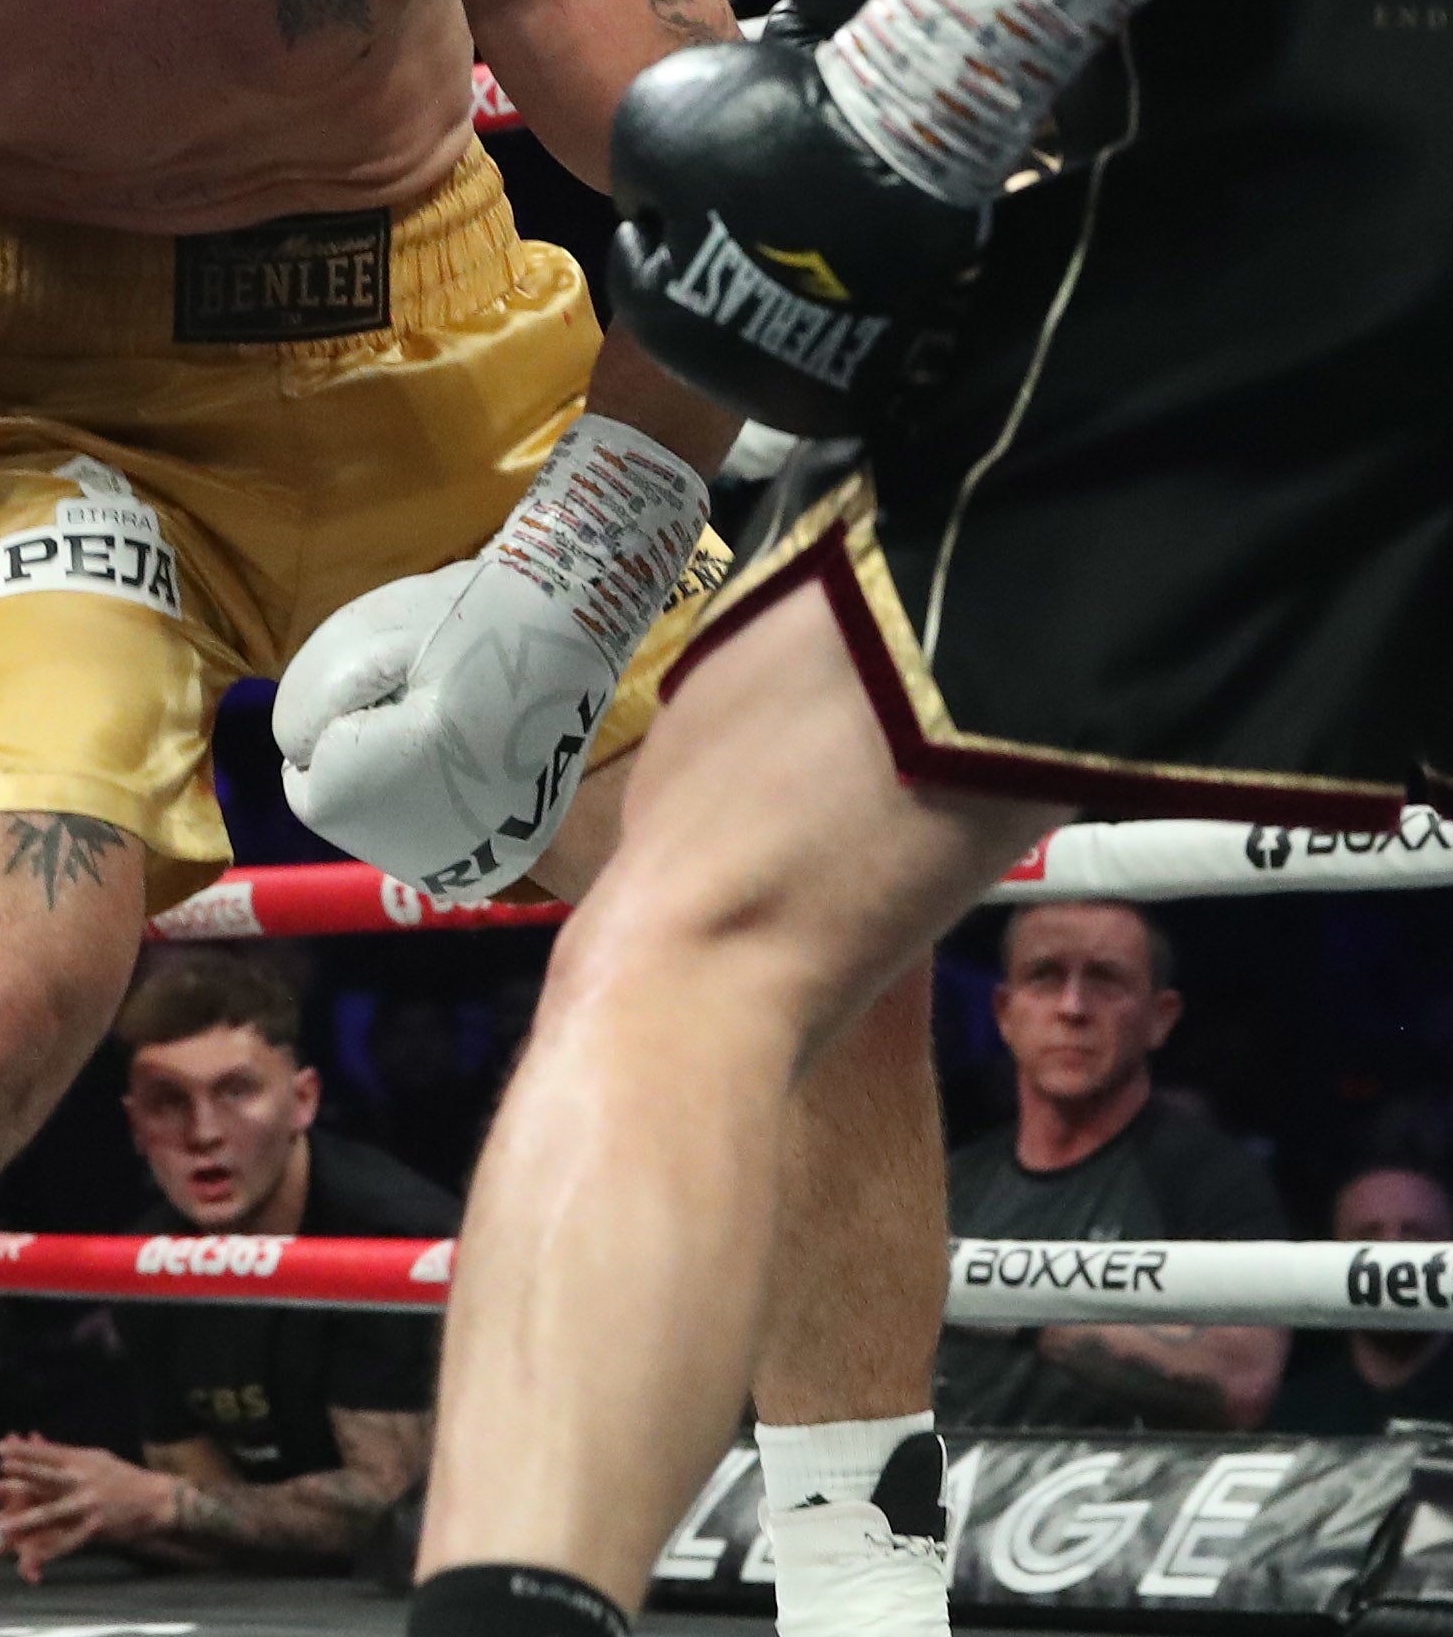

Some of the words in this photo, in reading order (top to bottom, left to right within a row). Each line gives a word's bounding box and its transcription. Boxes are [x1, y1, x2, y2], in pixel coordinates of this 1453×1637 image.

[198, 250, 375, 315] BENLEE
[666, 209, 893, 390] EVERLAST
[3, 534, 177, 608] PEJA
[420, 689, 607, 895] RIVAL
[965, 1248, 1170, 1293] BOXXER
